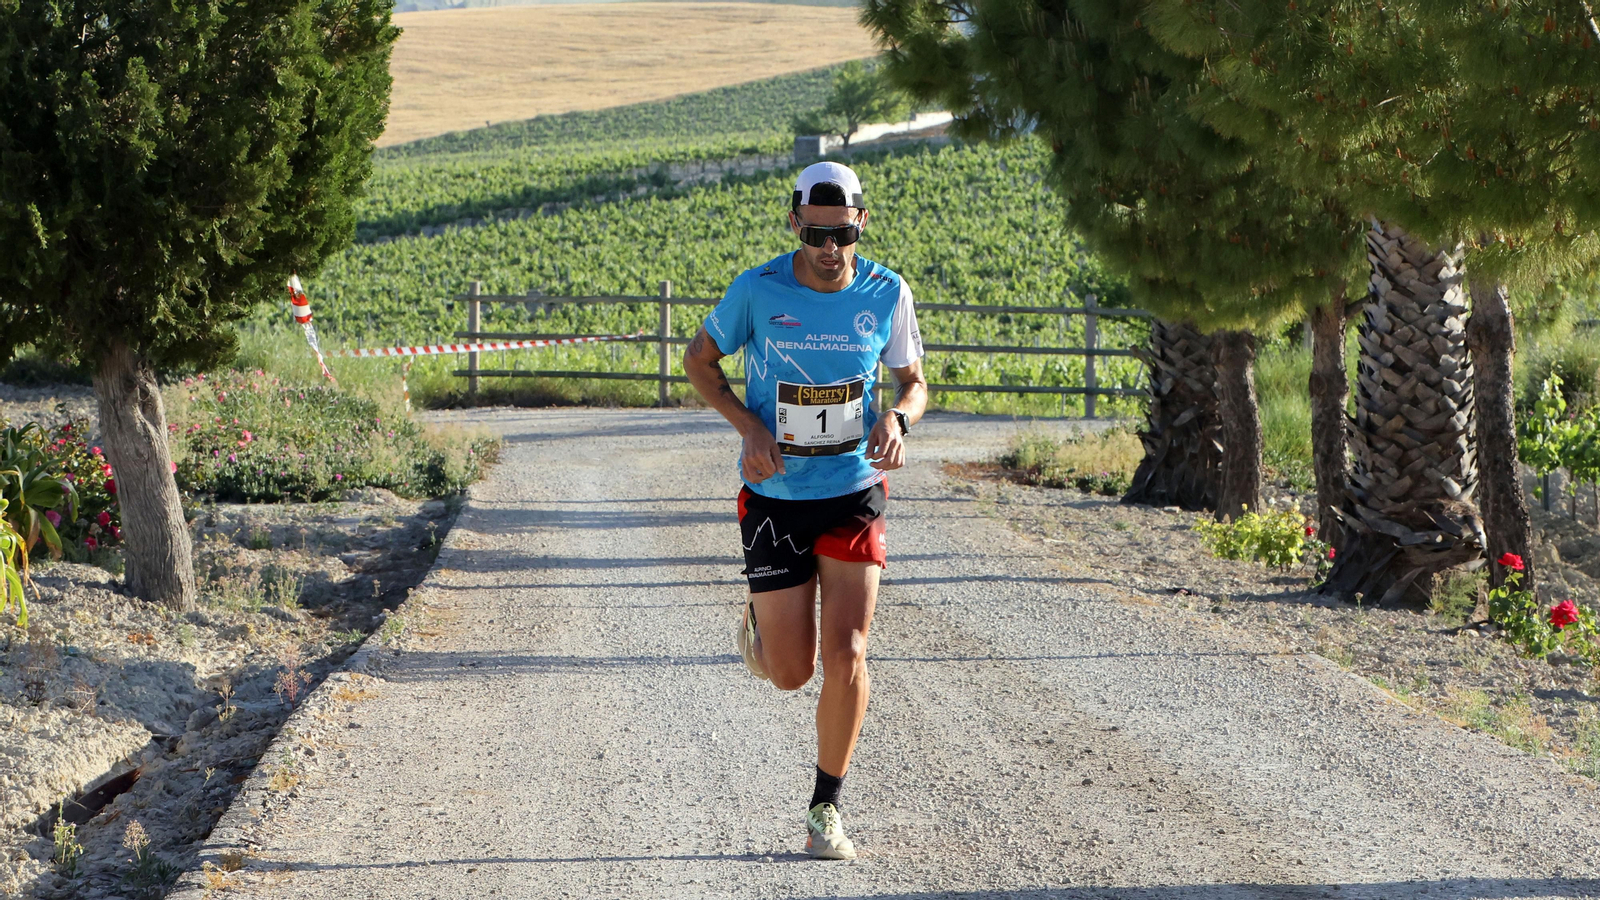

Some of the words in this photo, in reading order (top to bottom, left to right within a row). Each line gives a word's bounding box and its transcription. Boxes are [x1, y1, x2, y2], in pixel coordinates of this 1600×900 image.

[805, 333, 849, 342] ALPINO
[776, 340, 873, 352] BENALMADENA
[803, 388, 845, 401] Sherry
[816, 409, 827, 433] 1
